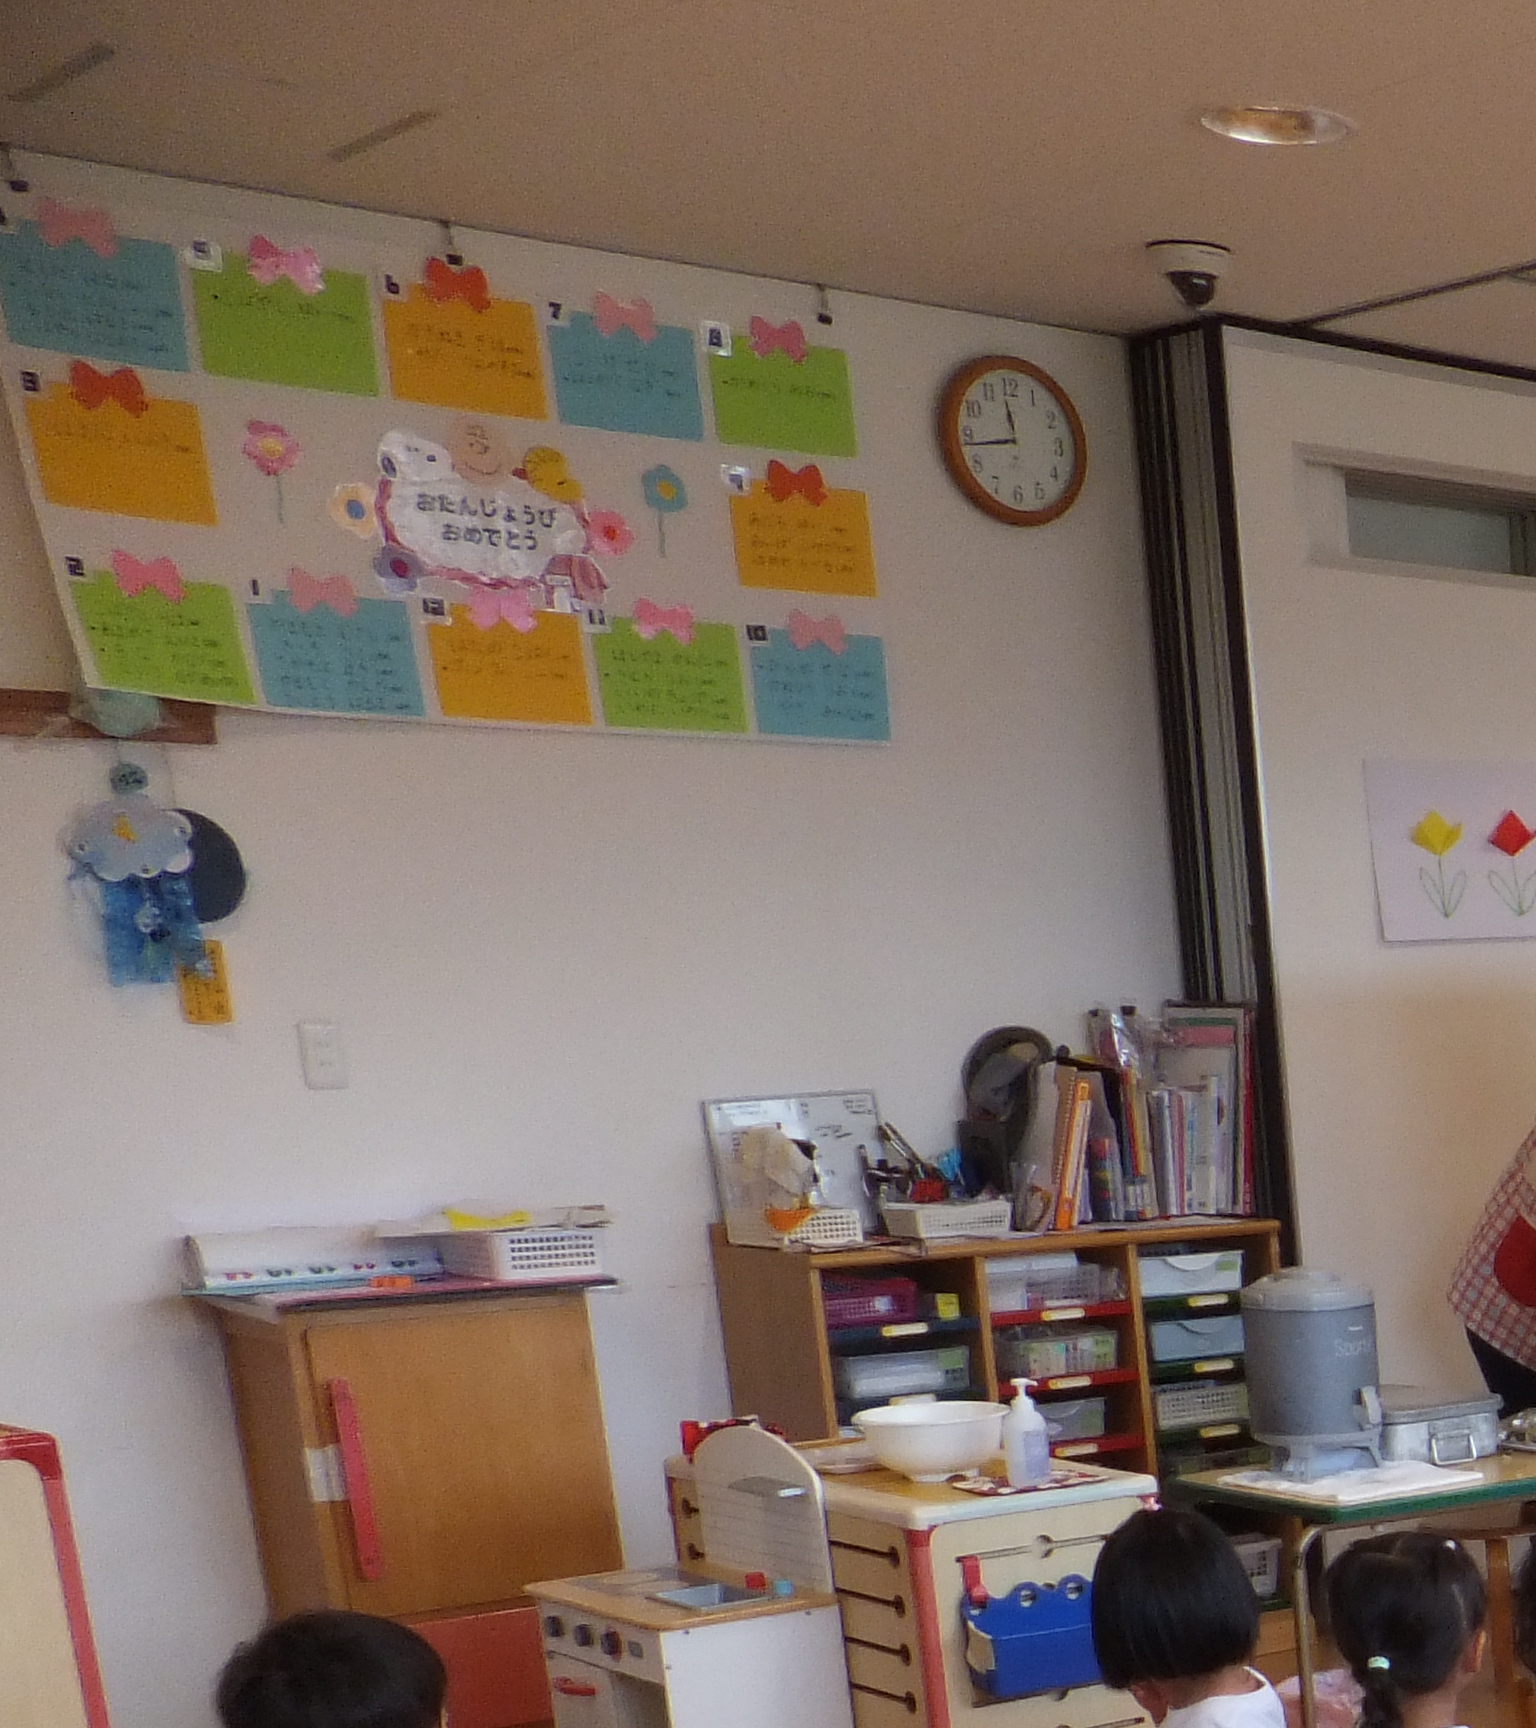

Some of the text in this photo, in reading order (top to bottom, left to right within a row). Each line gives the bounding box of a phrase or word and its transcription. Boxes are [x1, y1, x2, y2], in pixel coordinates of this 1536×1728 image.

[385, 274, 399, 294] 6
[548, 301, 562, 320] 7
[1002, 377, 1019, 398] 12
[1030, 389, 1036, 407] 1
[1046, 410, 1056, 429] 2
[1054, 437, 1064, 457] 3
[1050, 466, 1058, 481] 4
[992, 475, 999, 494] 7
[1013, 485, 1024, 503] 6
[417, 493, 557, 528] おたんじょうび
[442, 523, 539, 550] おめでとう
[65, 556, 85, 576] 2
[746, 624, 769, 641] 10
